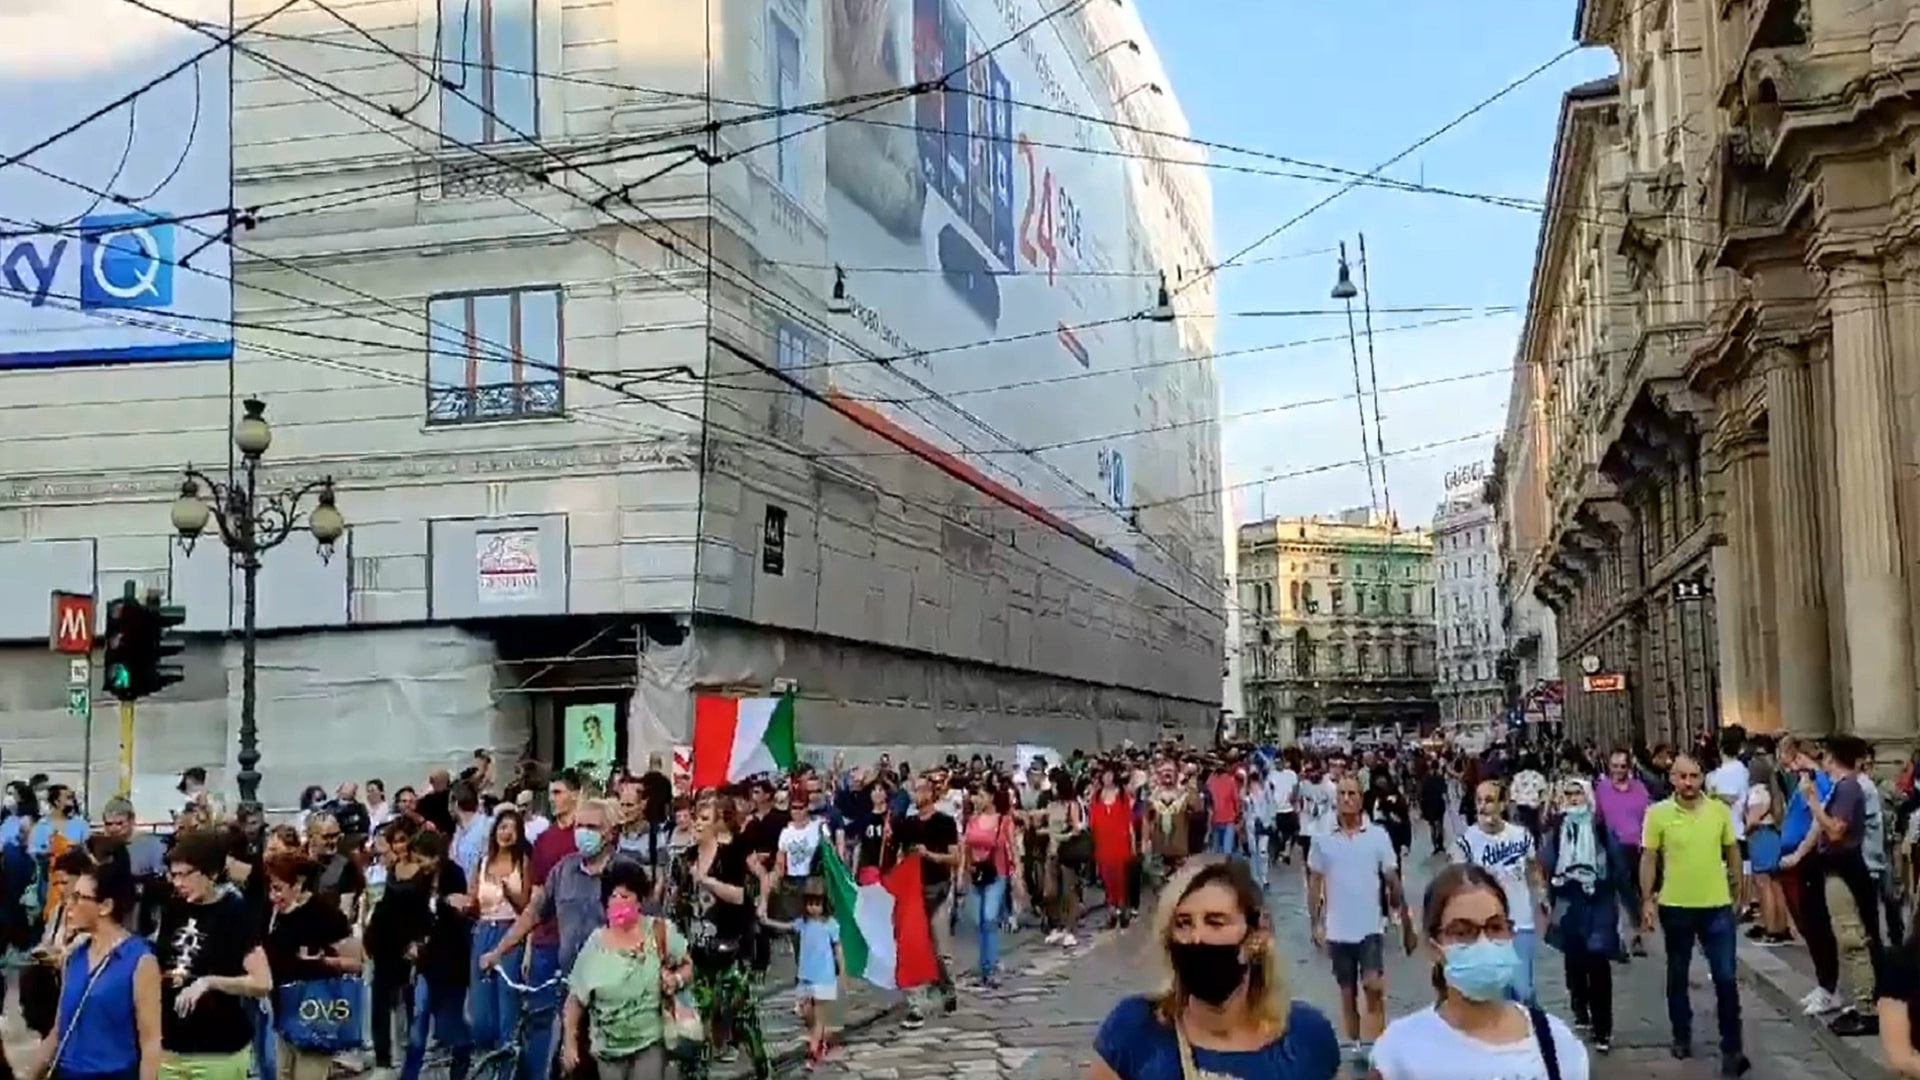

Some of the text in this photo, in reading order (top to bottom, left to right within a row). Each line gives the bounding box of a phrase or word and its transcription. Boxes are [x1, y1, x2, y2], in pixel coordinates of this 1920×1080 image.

[93, 228, 159, 298] Q
[60, 607, 87, 640] M
[299, 998, 350, 1021] OVS
